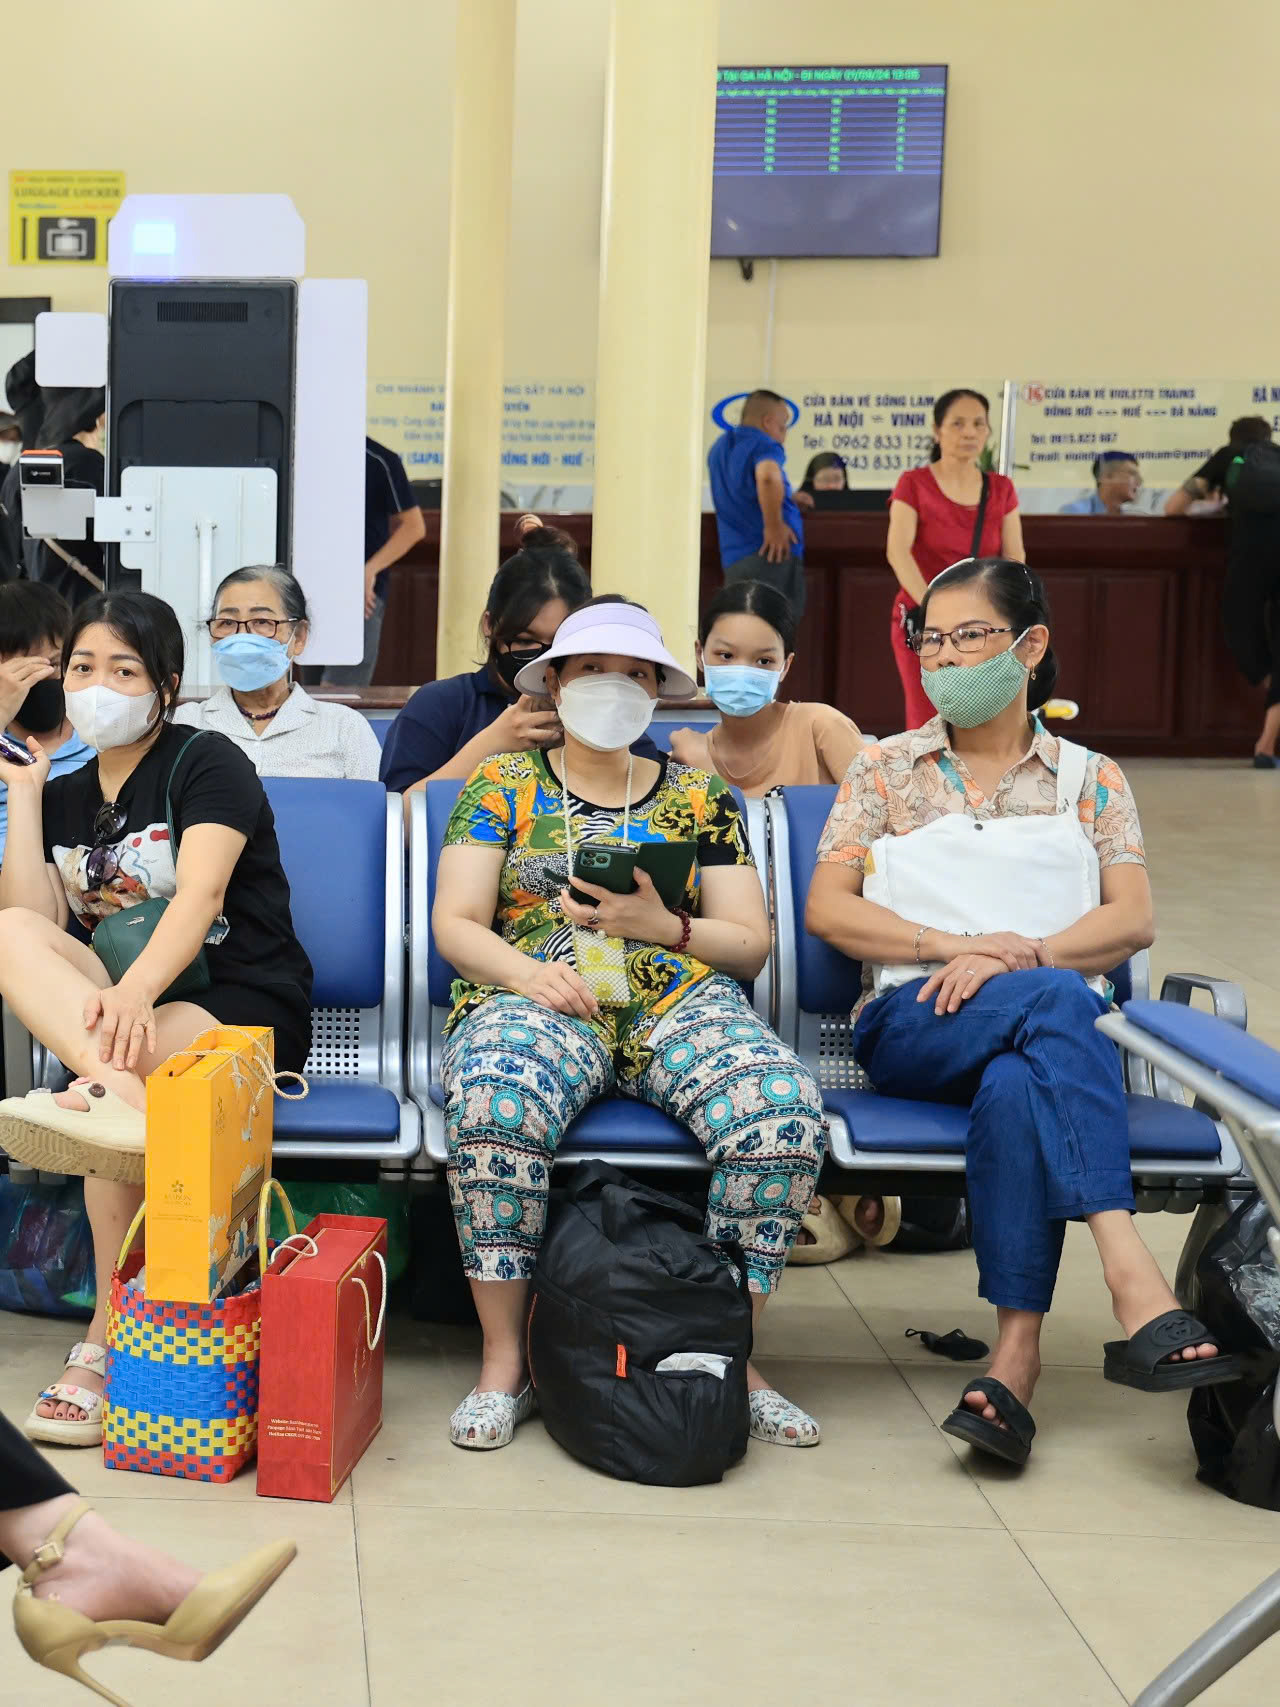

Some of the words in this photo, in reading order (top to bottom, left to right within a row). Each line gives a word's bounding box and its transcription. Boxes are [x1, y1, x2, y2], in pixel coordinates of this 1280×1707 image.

[814, 410, 833, 427] HÀ
[838, 410, 863, 429] NỘI
[891, 413, 925, 427] VINH
[832, 434, 869, 450] 0962
